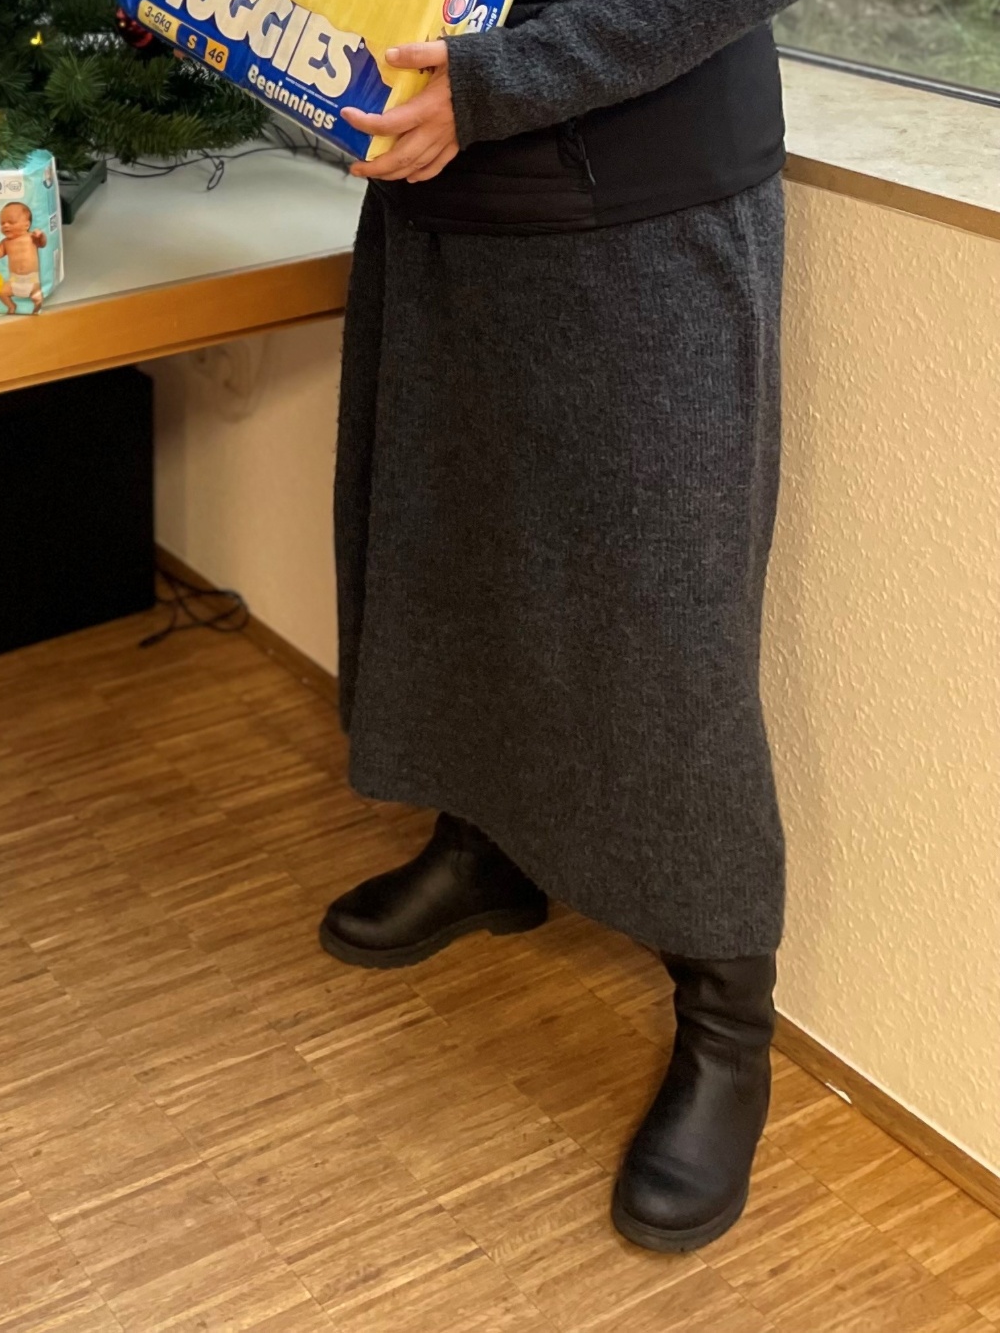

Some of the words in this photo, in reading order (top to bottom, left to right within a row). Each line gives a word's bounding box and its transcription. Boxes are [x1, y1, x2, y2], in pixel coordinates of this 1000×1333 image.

[143, 6, 172, 33] 3-6kg
[186, 34, 198, 49] S
[208, 47, 225, 64] 46
[247, 64, 336, 130] Beginnings
